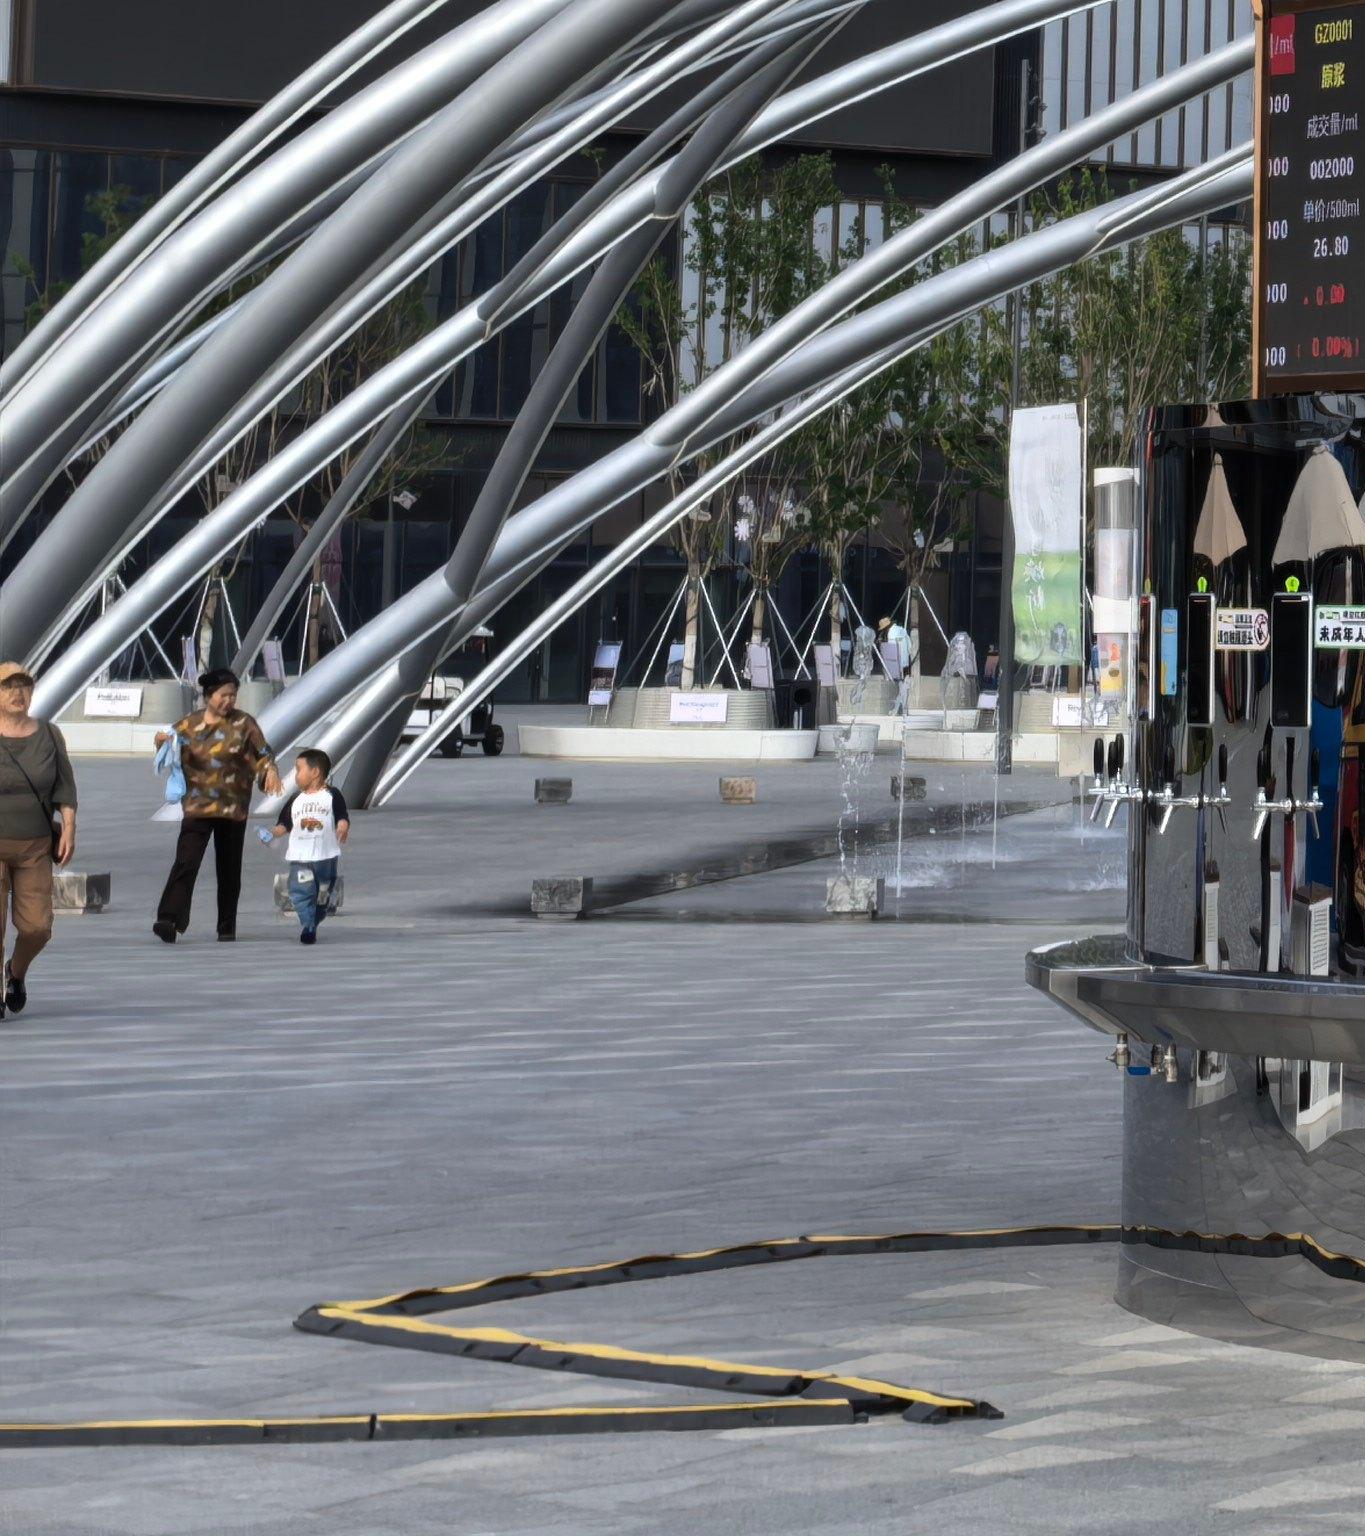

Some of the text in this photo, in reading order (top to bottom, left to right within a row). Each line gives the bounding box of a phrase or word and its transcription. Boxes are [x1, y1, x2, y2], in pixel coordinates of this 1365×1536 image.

[1314, 18, 1353, 44] GZ0001
[1306, 112, 1358, 139] 成交量/ml
[1309, 156, 1355, 180] 002000
[1303, 198, 1360, 223] 单价/500ml
[1313, 235, 1349, 258] 26.80
